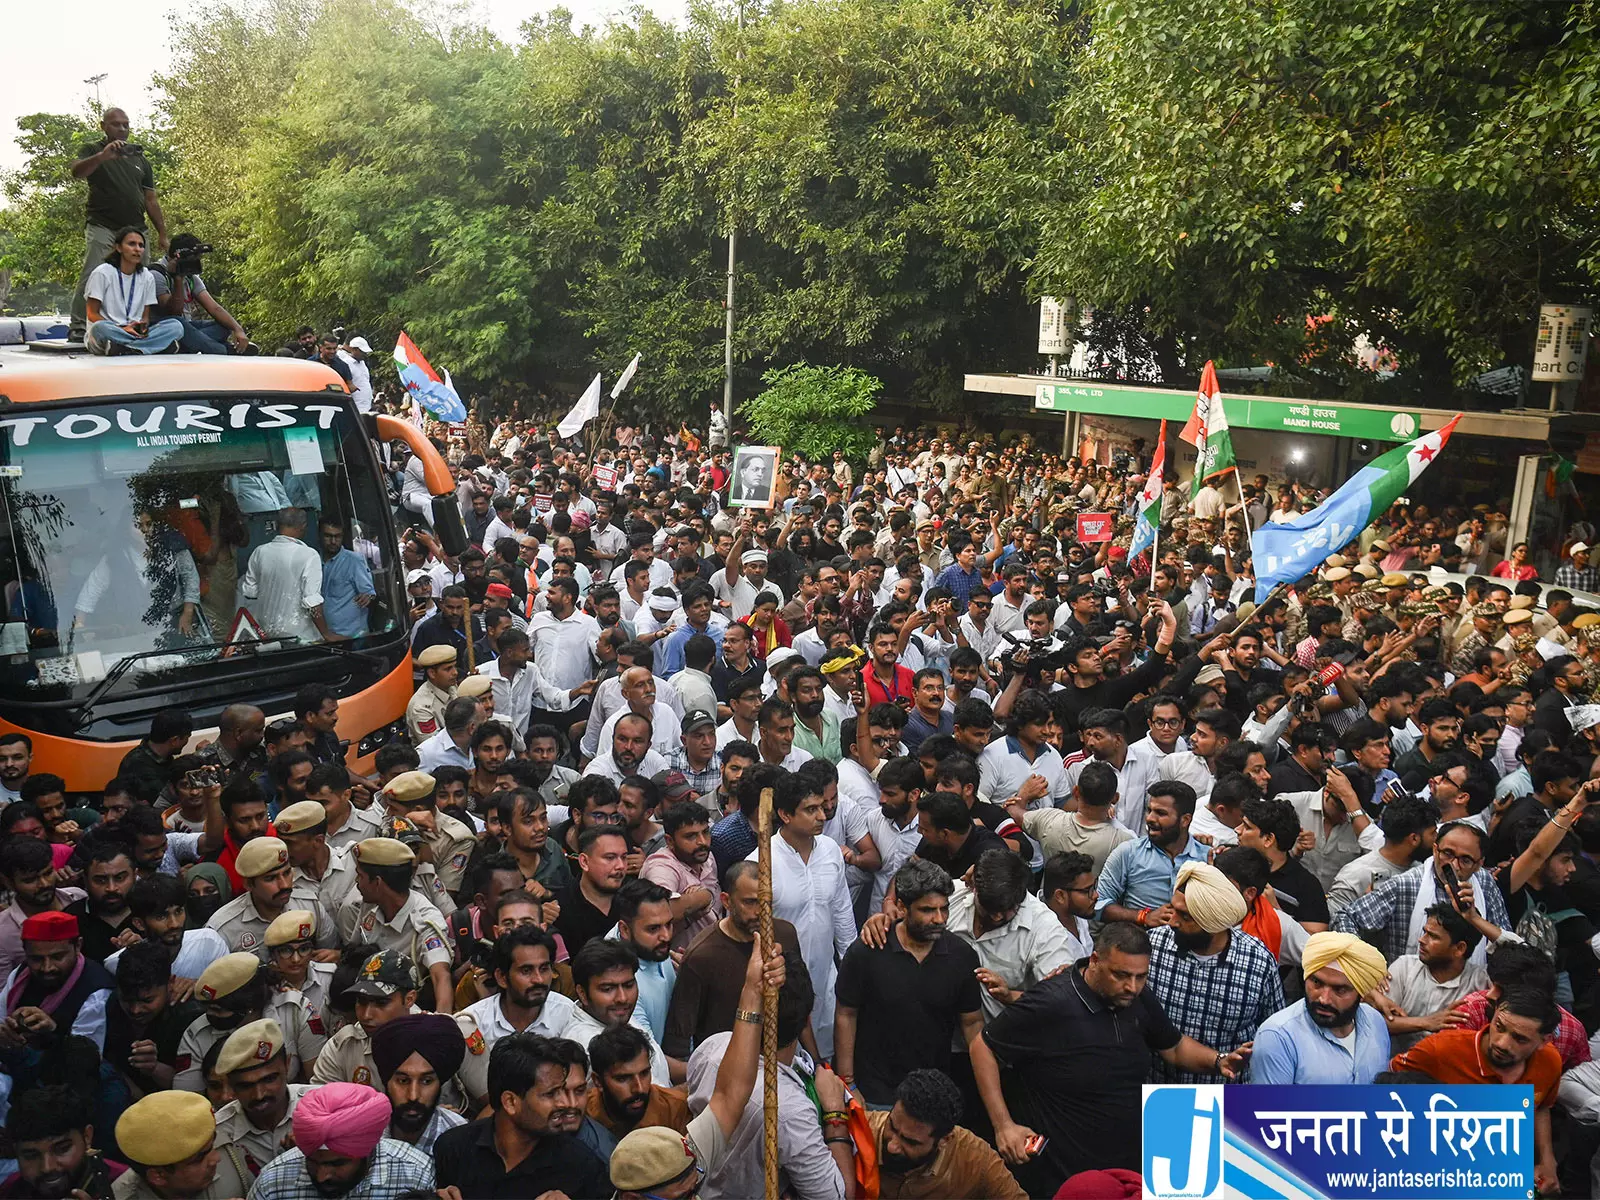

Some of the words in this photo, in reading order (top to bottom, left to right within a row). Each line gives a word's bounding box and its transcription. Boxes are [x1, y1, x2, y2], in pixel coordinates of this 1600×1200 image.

[1090, 389, 1103, 397] LTD
[1313, 408, 1337, 418] हाउस
[0, 404, 344, 446] TOURIST
[1283, 417, 1310, 427] MANDI
[1312, 421, 1341, 430] HOUSE
[137, 436, 150, 447] ALL
[150, 434, 169, 446] INDIA
[169, 433, 197, 445] TOURIST
[198, 432, 222, 443] PERMIT
